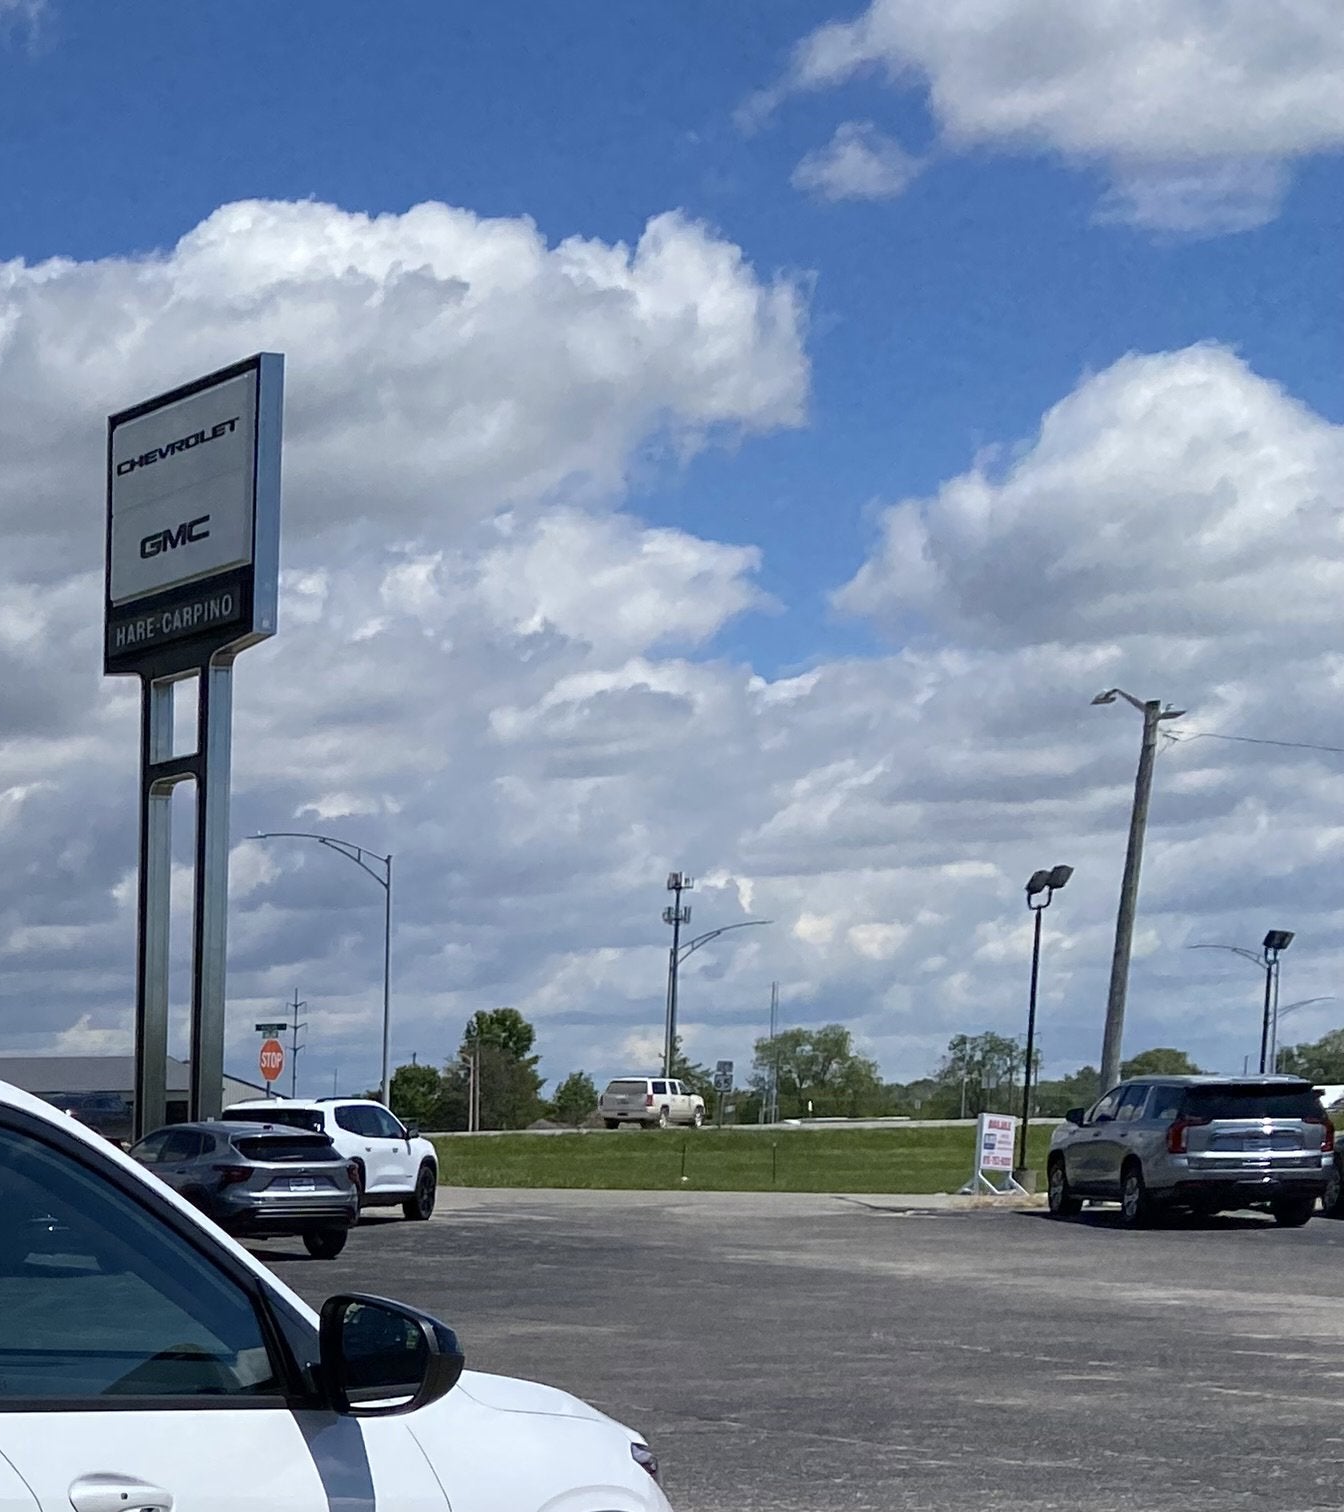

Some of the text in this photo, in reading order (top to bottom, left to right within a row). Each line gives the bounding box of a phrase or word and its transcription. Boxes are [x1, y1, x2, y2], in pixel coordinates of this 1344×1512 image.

[116, 416, 240, 477] CHEVROLET
[140, 515, 210, 559] GMC
[116, 595, 232, 647] HARE-CARPINO
[261, 1051, 283, 1069] STOP
